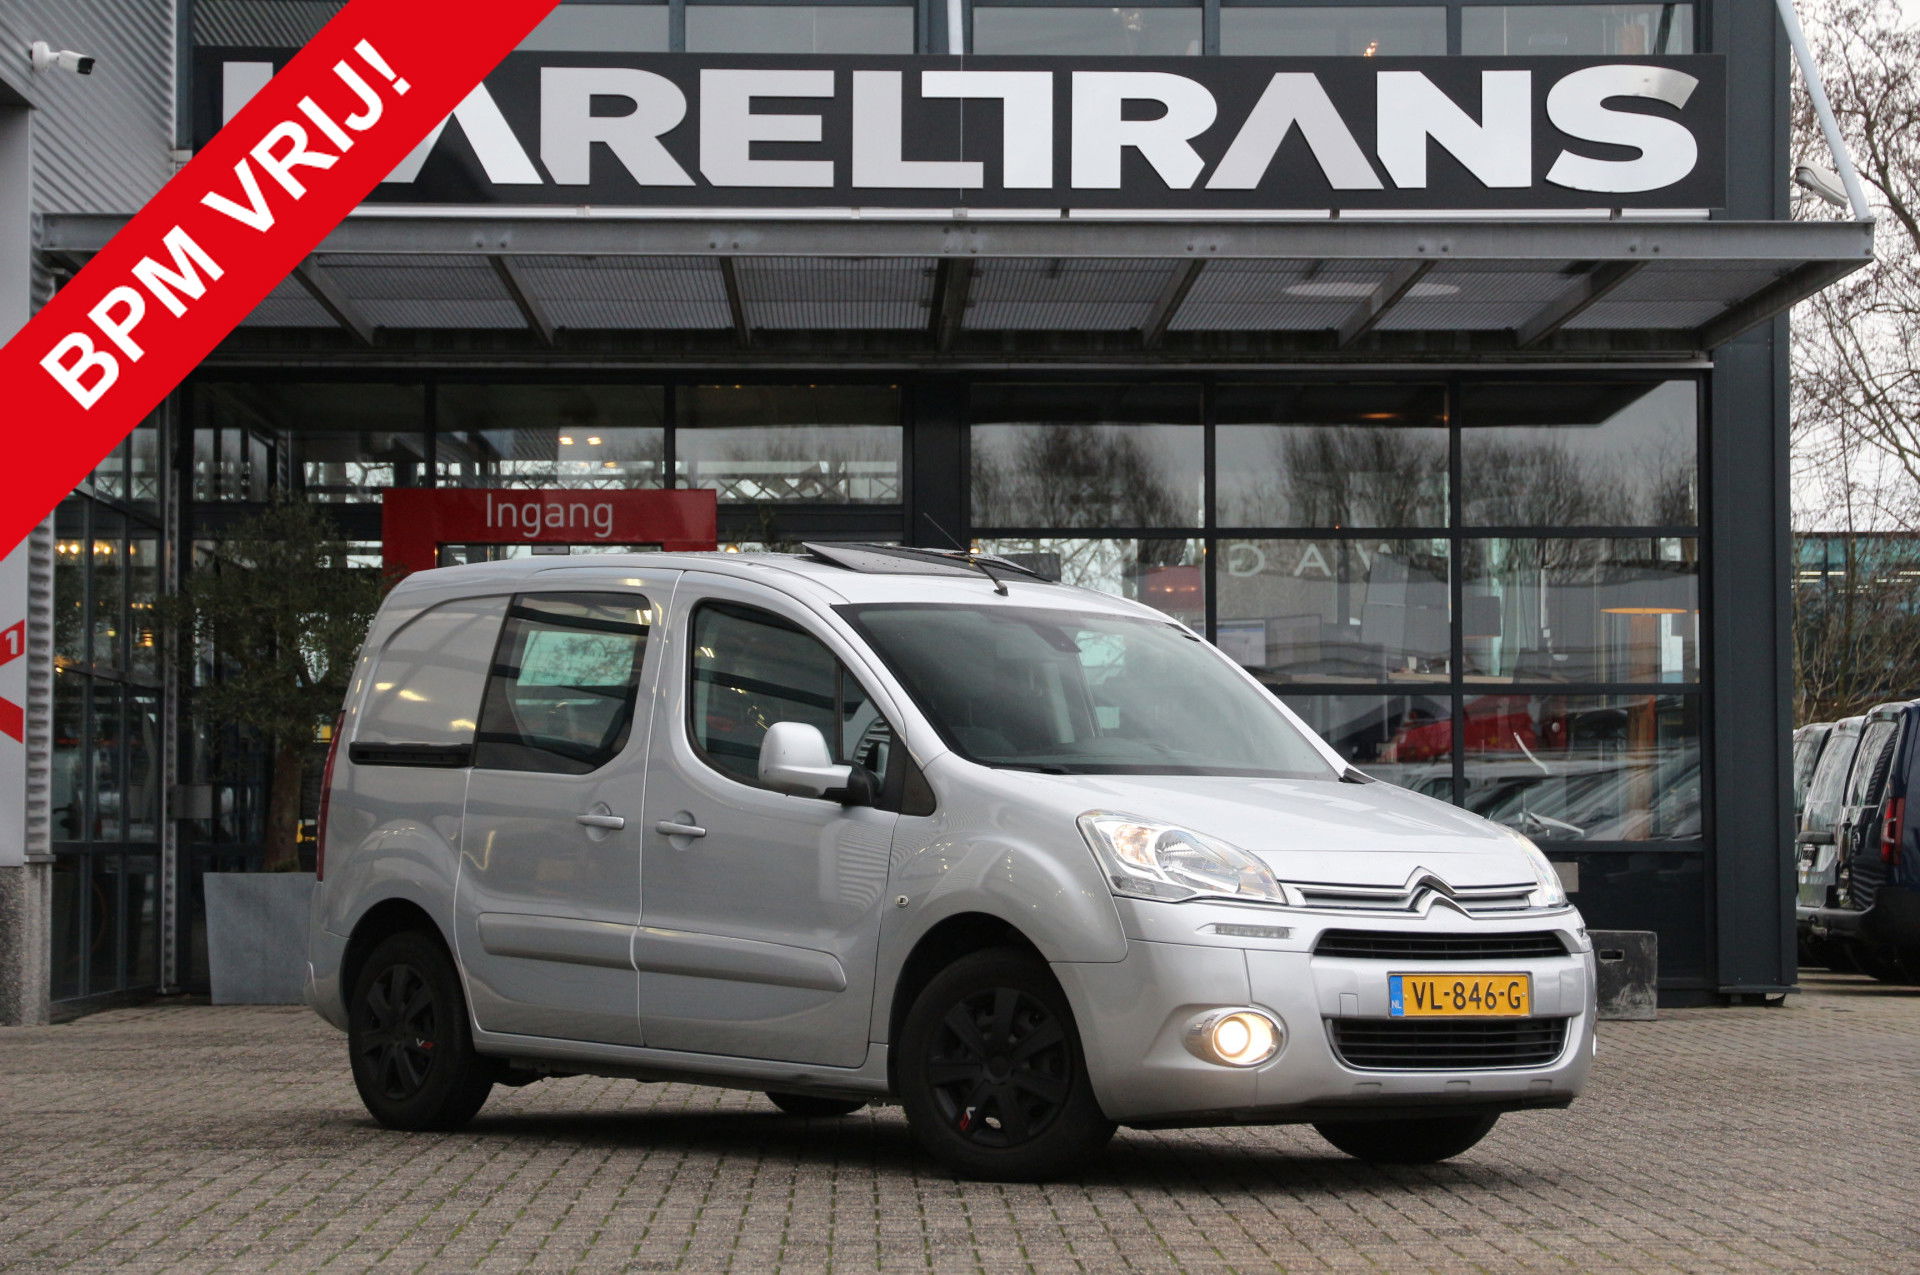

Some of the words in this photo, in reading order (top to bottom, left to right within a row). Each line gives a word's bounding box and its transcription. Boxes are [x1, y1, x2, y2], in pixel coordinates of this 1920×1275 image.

[223, 61, 1699, 193] ARELTRANS
[486, 493, 613, 538] Ingang
[1391, 1001, 1402, 1009] NL
[1412, 981, 1521, 1010] VL-846-G
